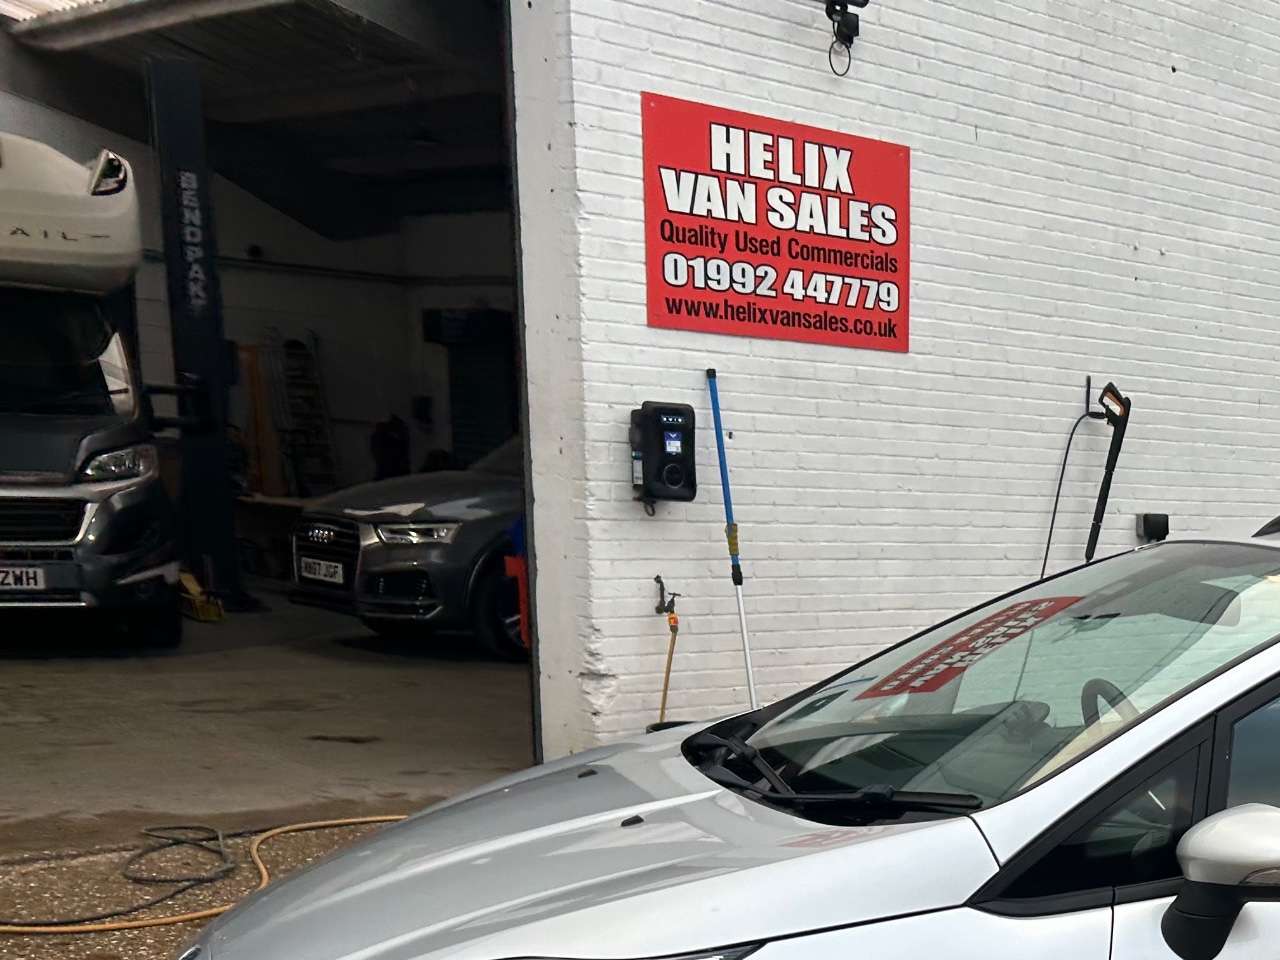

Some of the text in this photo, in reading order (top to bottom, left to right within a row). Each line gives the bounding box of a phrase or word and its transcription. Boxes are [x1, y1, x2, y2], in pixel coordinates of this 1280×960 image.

[710, 122, 854, 194] HELIX
[658, 165, 898, 245] VAN SALES
[660, 219, 898, 273] Quality Used Commercials
[662, 252, 900, 312] 01992 447779
[665, 297, 897, 339] www.helixvansales.co.uk
